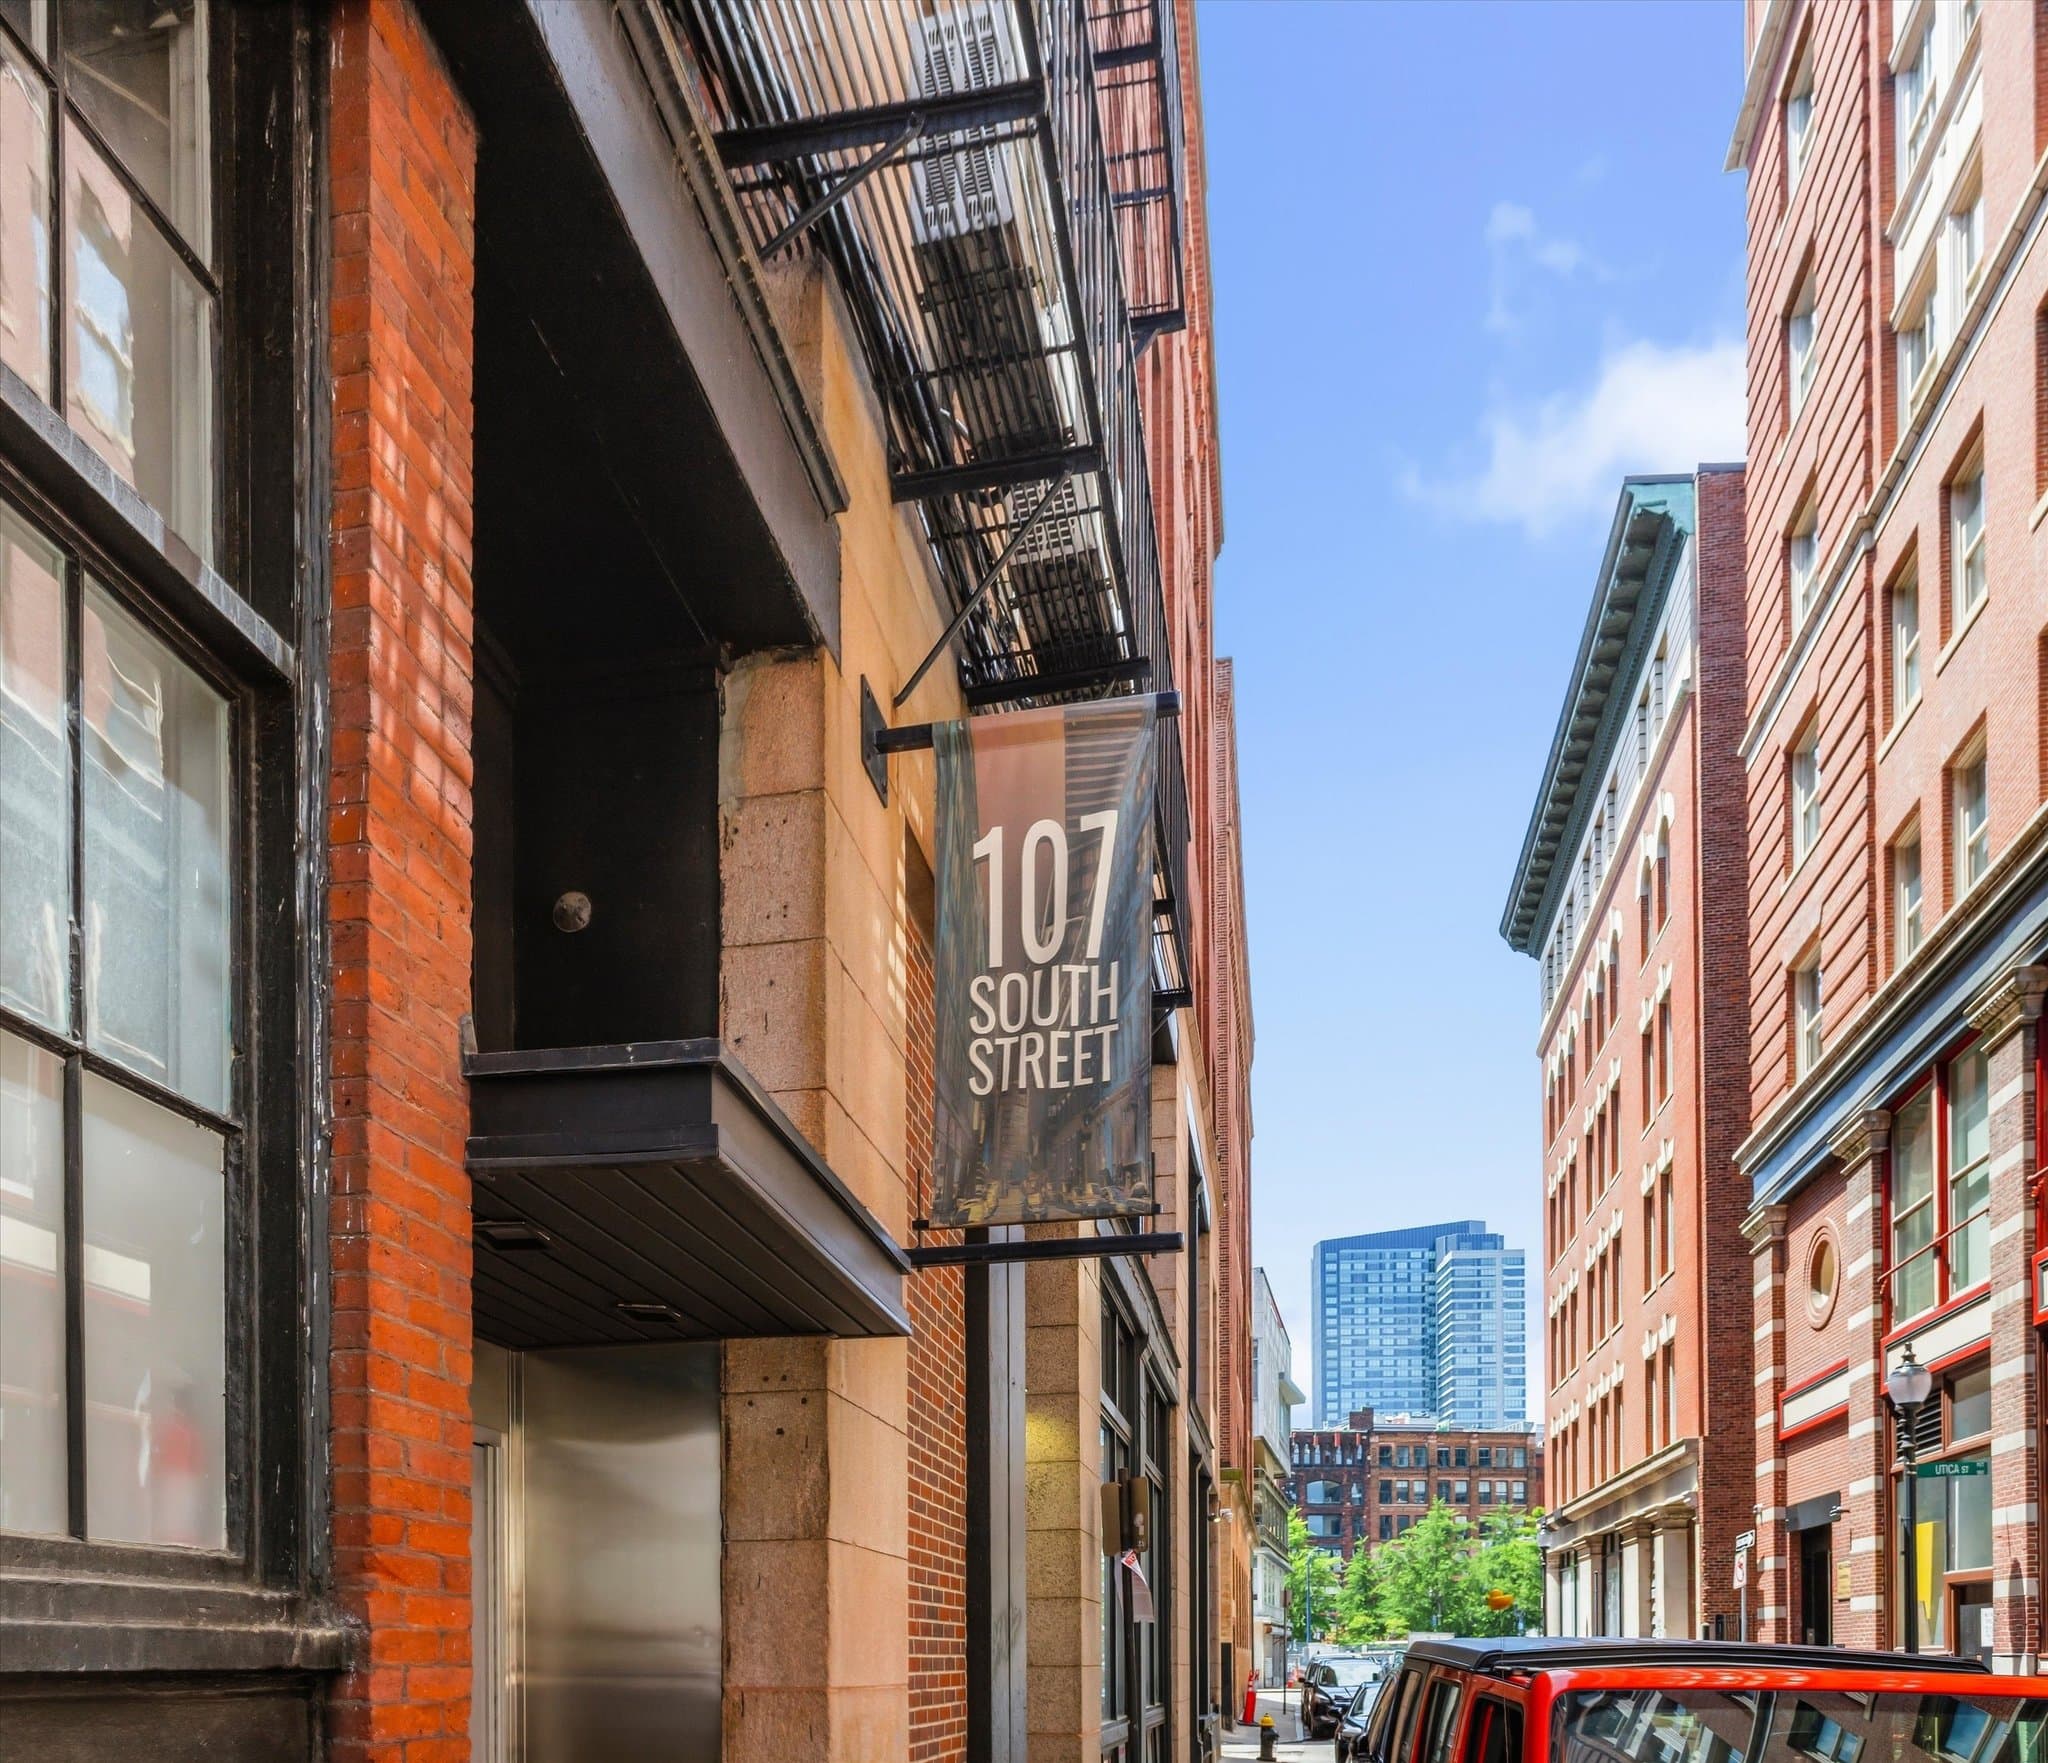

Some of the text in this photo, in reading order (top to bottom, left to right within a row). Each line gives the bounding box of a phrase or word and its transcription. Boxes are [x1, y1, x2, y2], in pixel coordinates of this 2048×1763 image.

[972, 809, 1119, 968] 107
[969, 960, 1119, 1035] SOUTH
[969, 1024, 1119, 1096] STREET
[1935, 1464, 1960, 1475] UTICA
